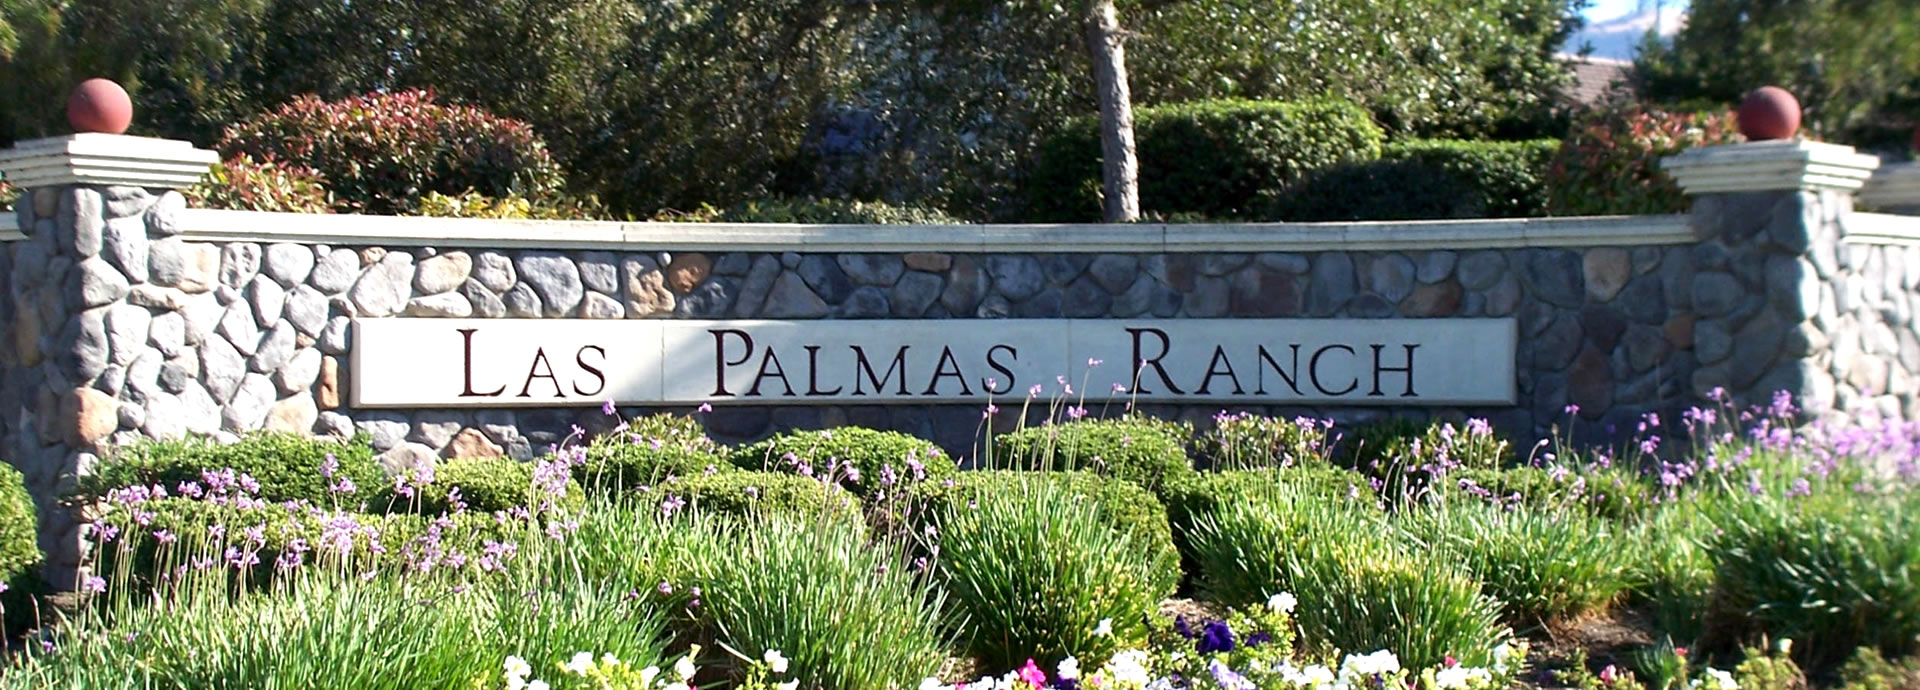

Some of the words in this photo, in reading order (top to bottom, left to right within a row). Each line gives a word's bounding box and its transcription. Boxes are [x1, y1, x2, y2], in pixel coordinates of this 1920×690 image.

[457, 328, 607, 398] LAS
[707, 329, 1018, 397] PALMAS
[1125, 327, 1421, 397] RANCH
